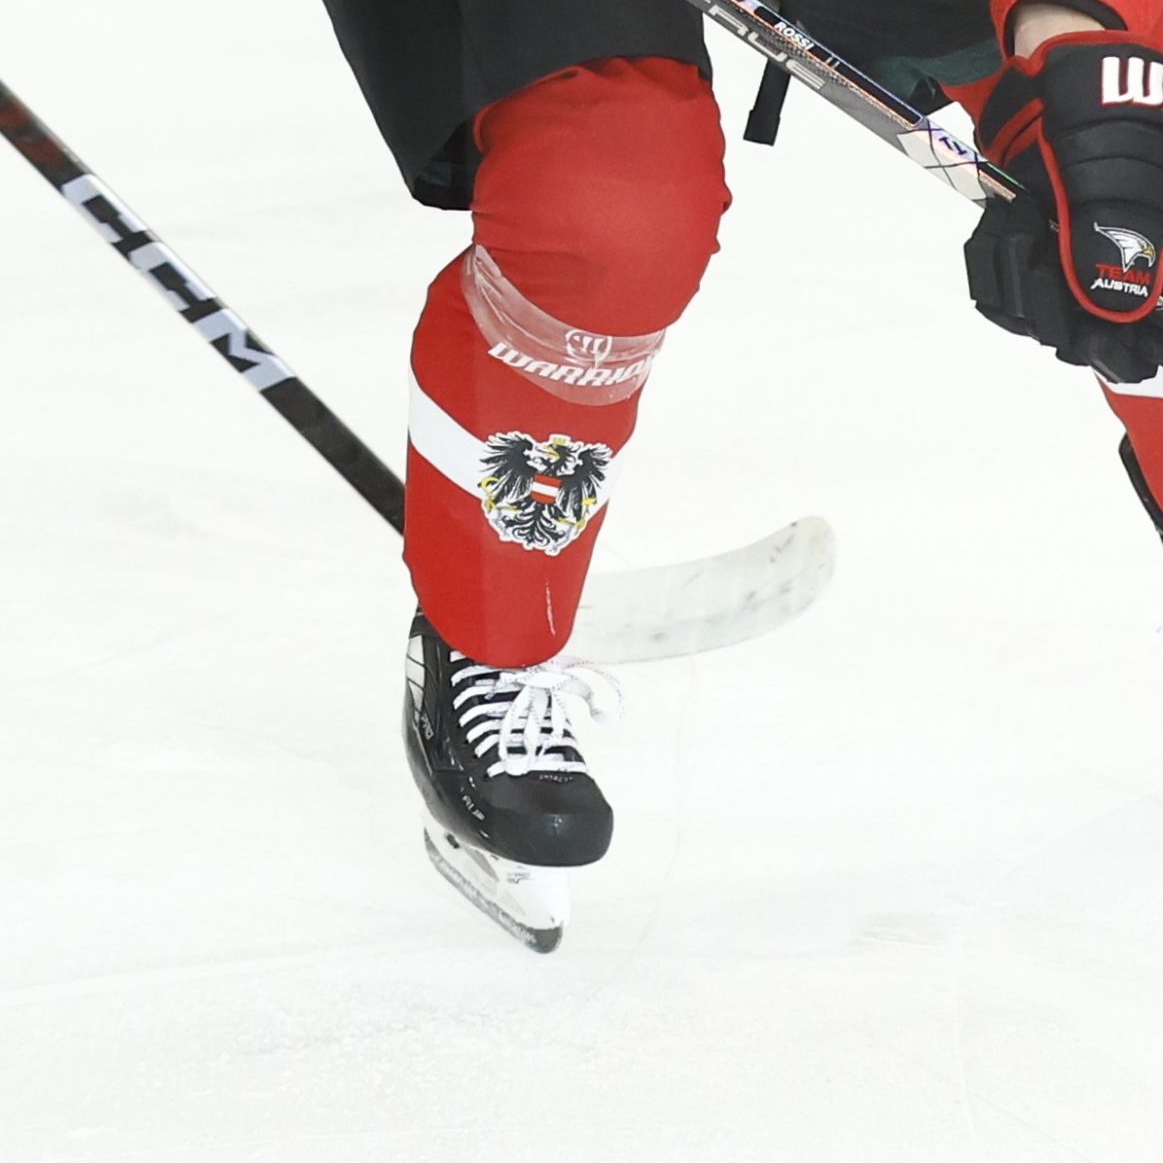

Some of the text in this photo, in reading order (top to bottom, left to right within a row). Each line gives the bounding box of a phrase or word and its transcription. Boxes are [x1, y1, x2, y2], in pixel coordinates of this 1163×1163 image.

[773, 21, 815, 52] ROSSI
[60, 173, 298, 393] CCM
[1090, 277, 1149, 298] AUSTRIA
[1095, 263, 1152, 286] TEAM
[487, 341, 656, 387] WARRIO
